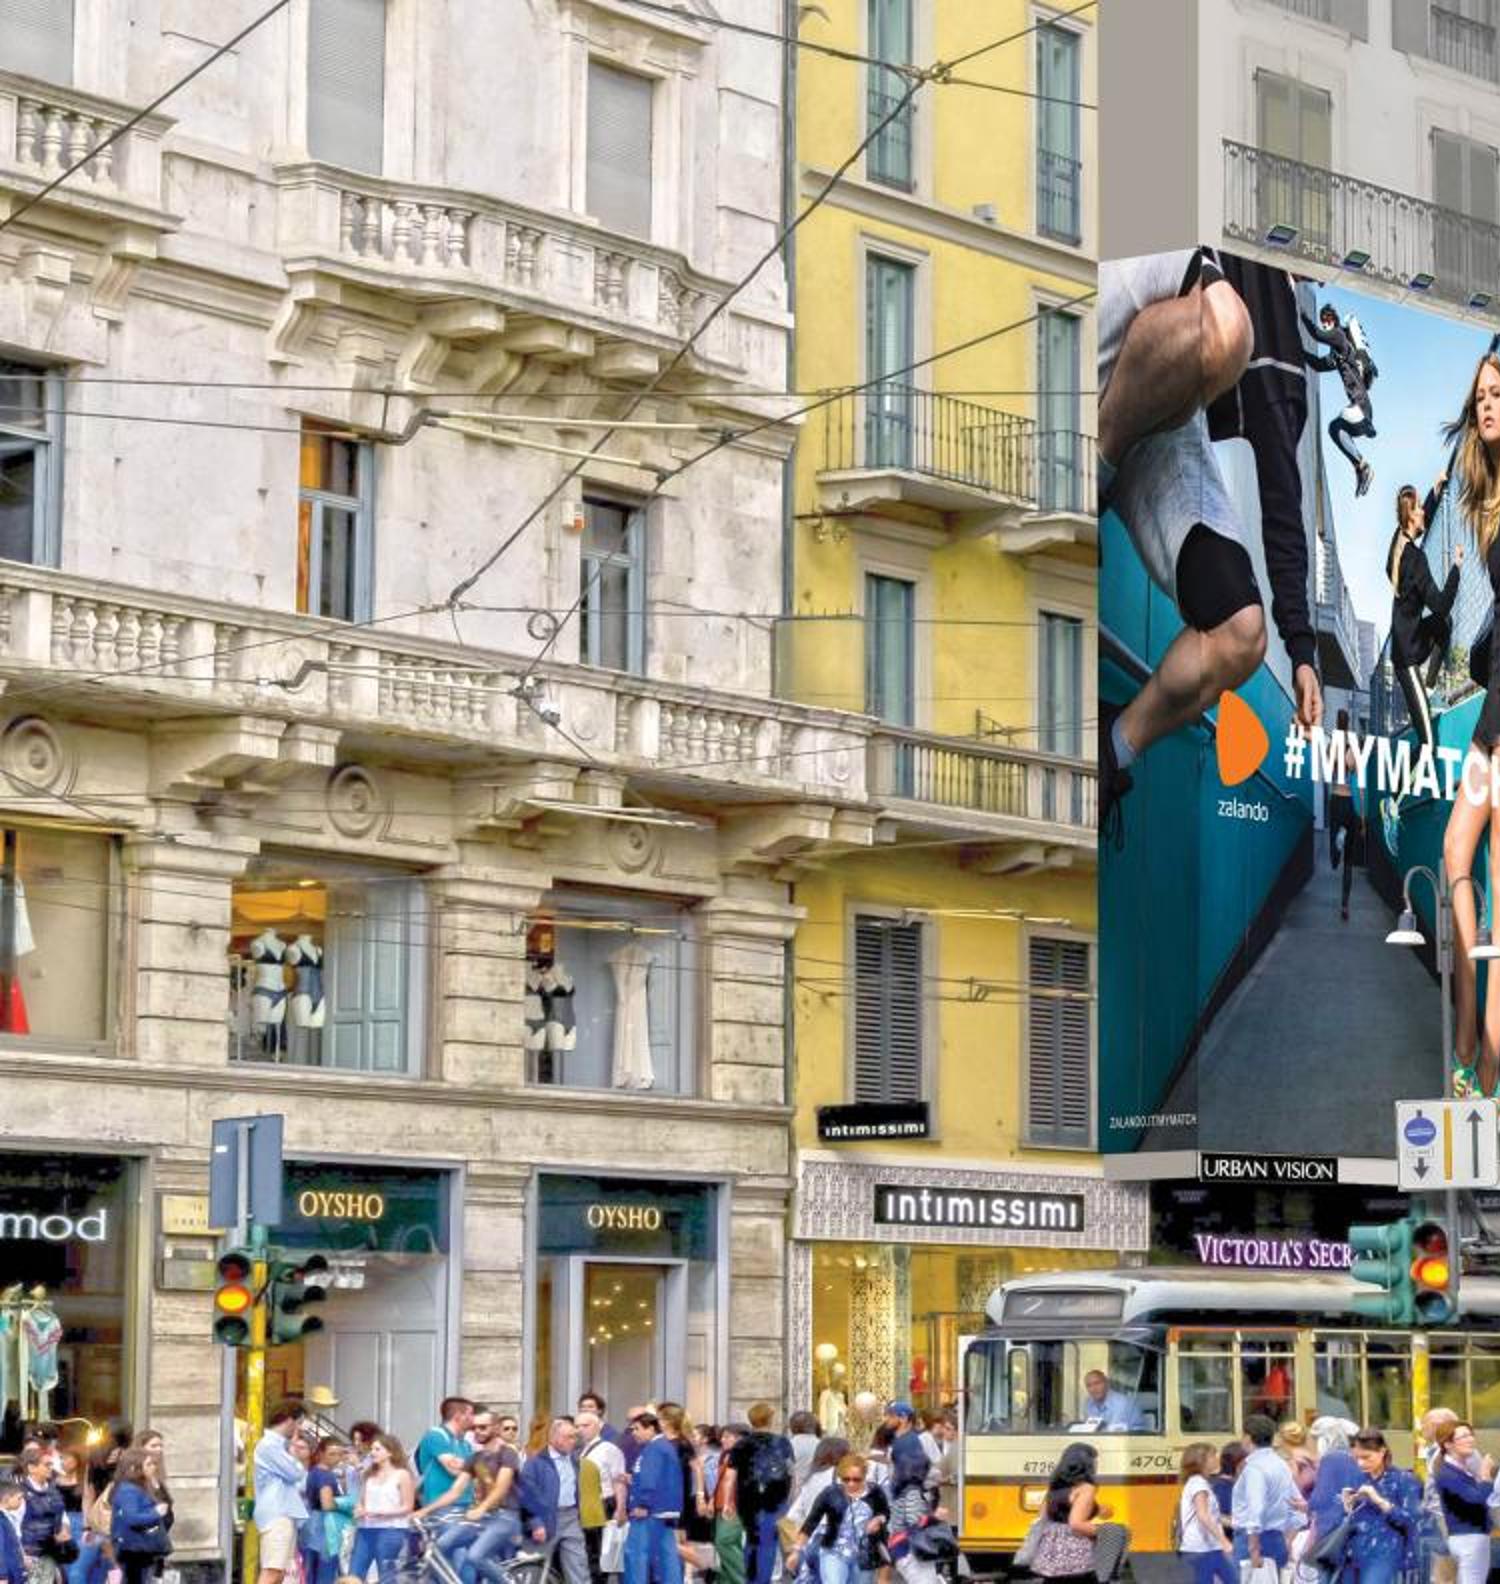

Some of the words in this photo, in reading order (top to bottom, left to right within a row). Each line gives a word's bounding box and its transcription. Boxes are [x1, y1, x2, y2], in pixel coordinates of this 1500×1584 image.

[1217, 797, 1269, 822] zalando
[825, 1122, 926, 1137] intimissimi
[1204, 1158, 1268, 1178] URBAN
[1275, 1160, 1335, 1180] VISION
[299, 1191, 384, 1219] OYSHO
[587, 1204, 661, 1230] OYSHO
[886, 1189, 1078, 1229] intimissimi
[1196, 1234, 1303, 1266] VICTORIA'S
[1309, 1238, 1352, 1267] SECR
